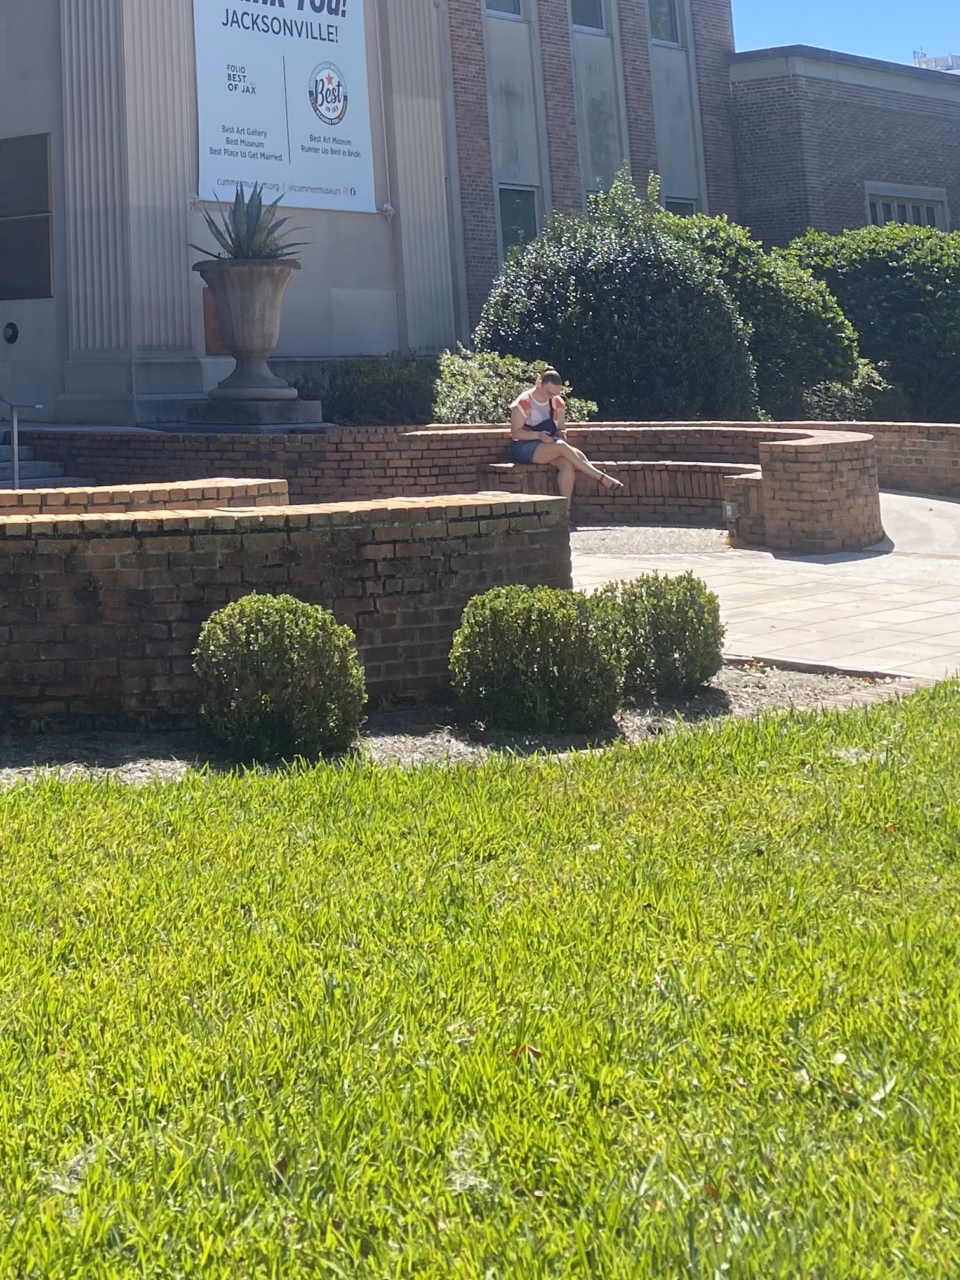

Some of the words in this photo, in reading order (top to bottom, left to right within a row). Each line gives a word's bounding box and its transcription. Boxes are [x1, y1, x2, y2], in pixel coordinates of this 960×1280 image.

[222, 8, 339, 44] JACKSONVILLE!
[226, 64, 246, 74] FOLIO
[227, 73, 247, 84] BEST
[227, 82, 239, 93] OF
[241, 85, 257, 95] JAX
[314, 78, 343, 107] Best
[221, 124, 235, 134] Best
[236, 126, 246, 136] Art
[246, 127, 268, 139] Gallery
[225, 136, 239, 146] Best
[239, 138, 265, 149] Museum
[309, 134, 321, 143] Best
[322, 135, 331, 145] Art
[331, 136, 352, 147] Museum
[209, 146, 222, 156] Best
[223, 148, 239, 158] Place
[240, 150, 247, 159] to
[247, 150, 259, 160] Get
[259, 151, 283, 162] Married
[300, 144, 320, 155] Runner
[320, 146, 330, 156] Up
[329, 147, 342, 157] Best
